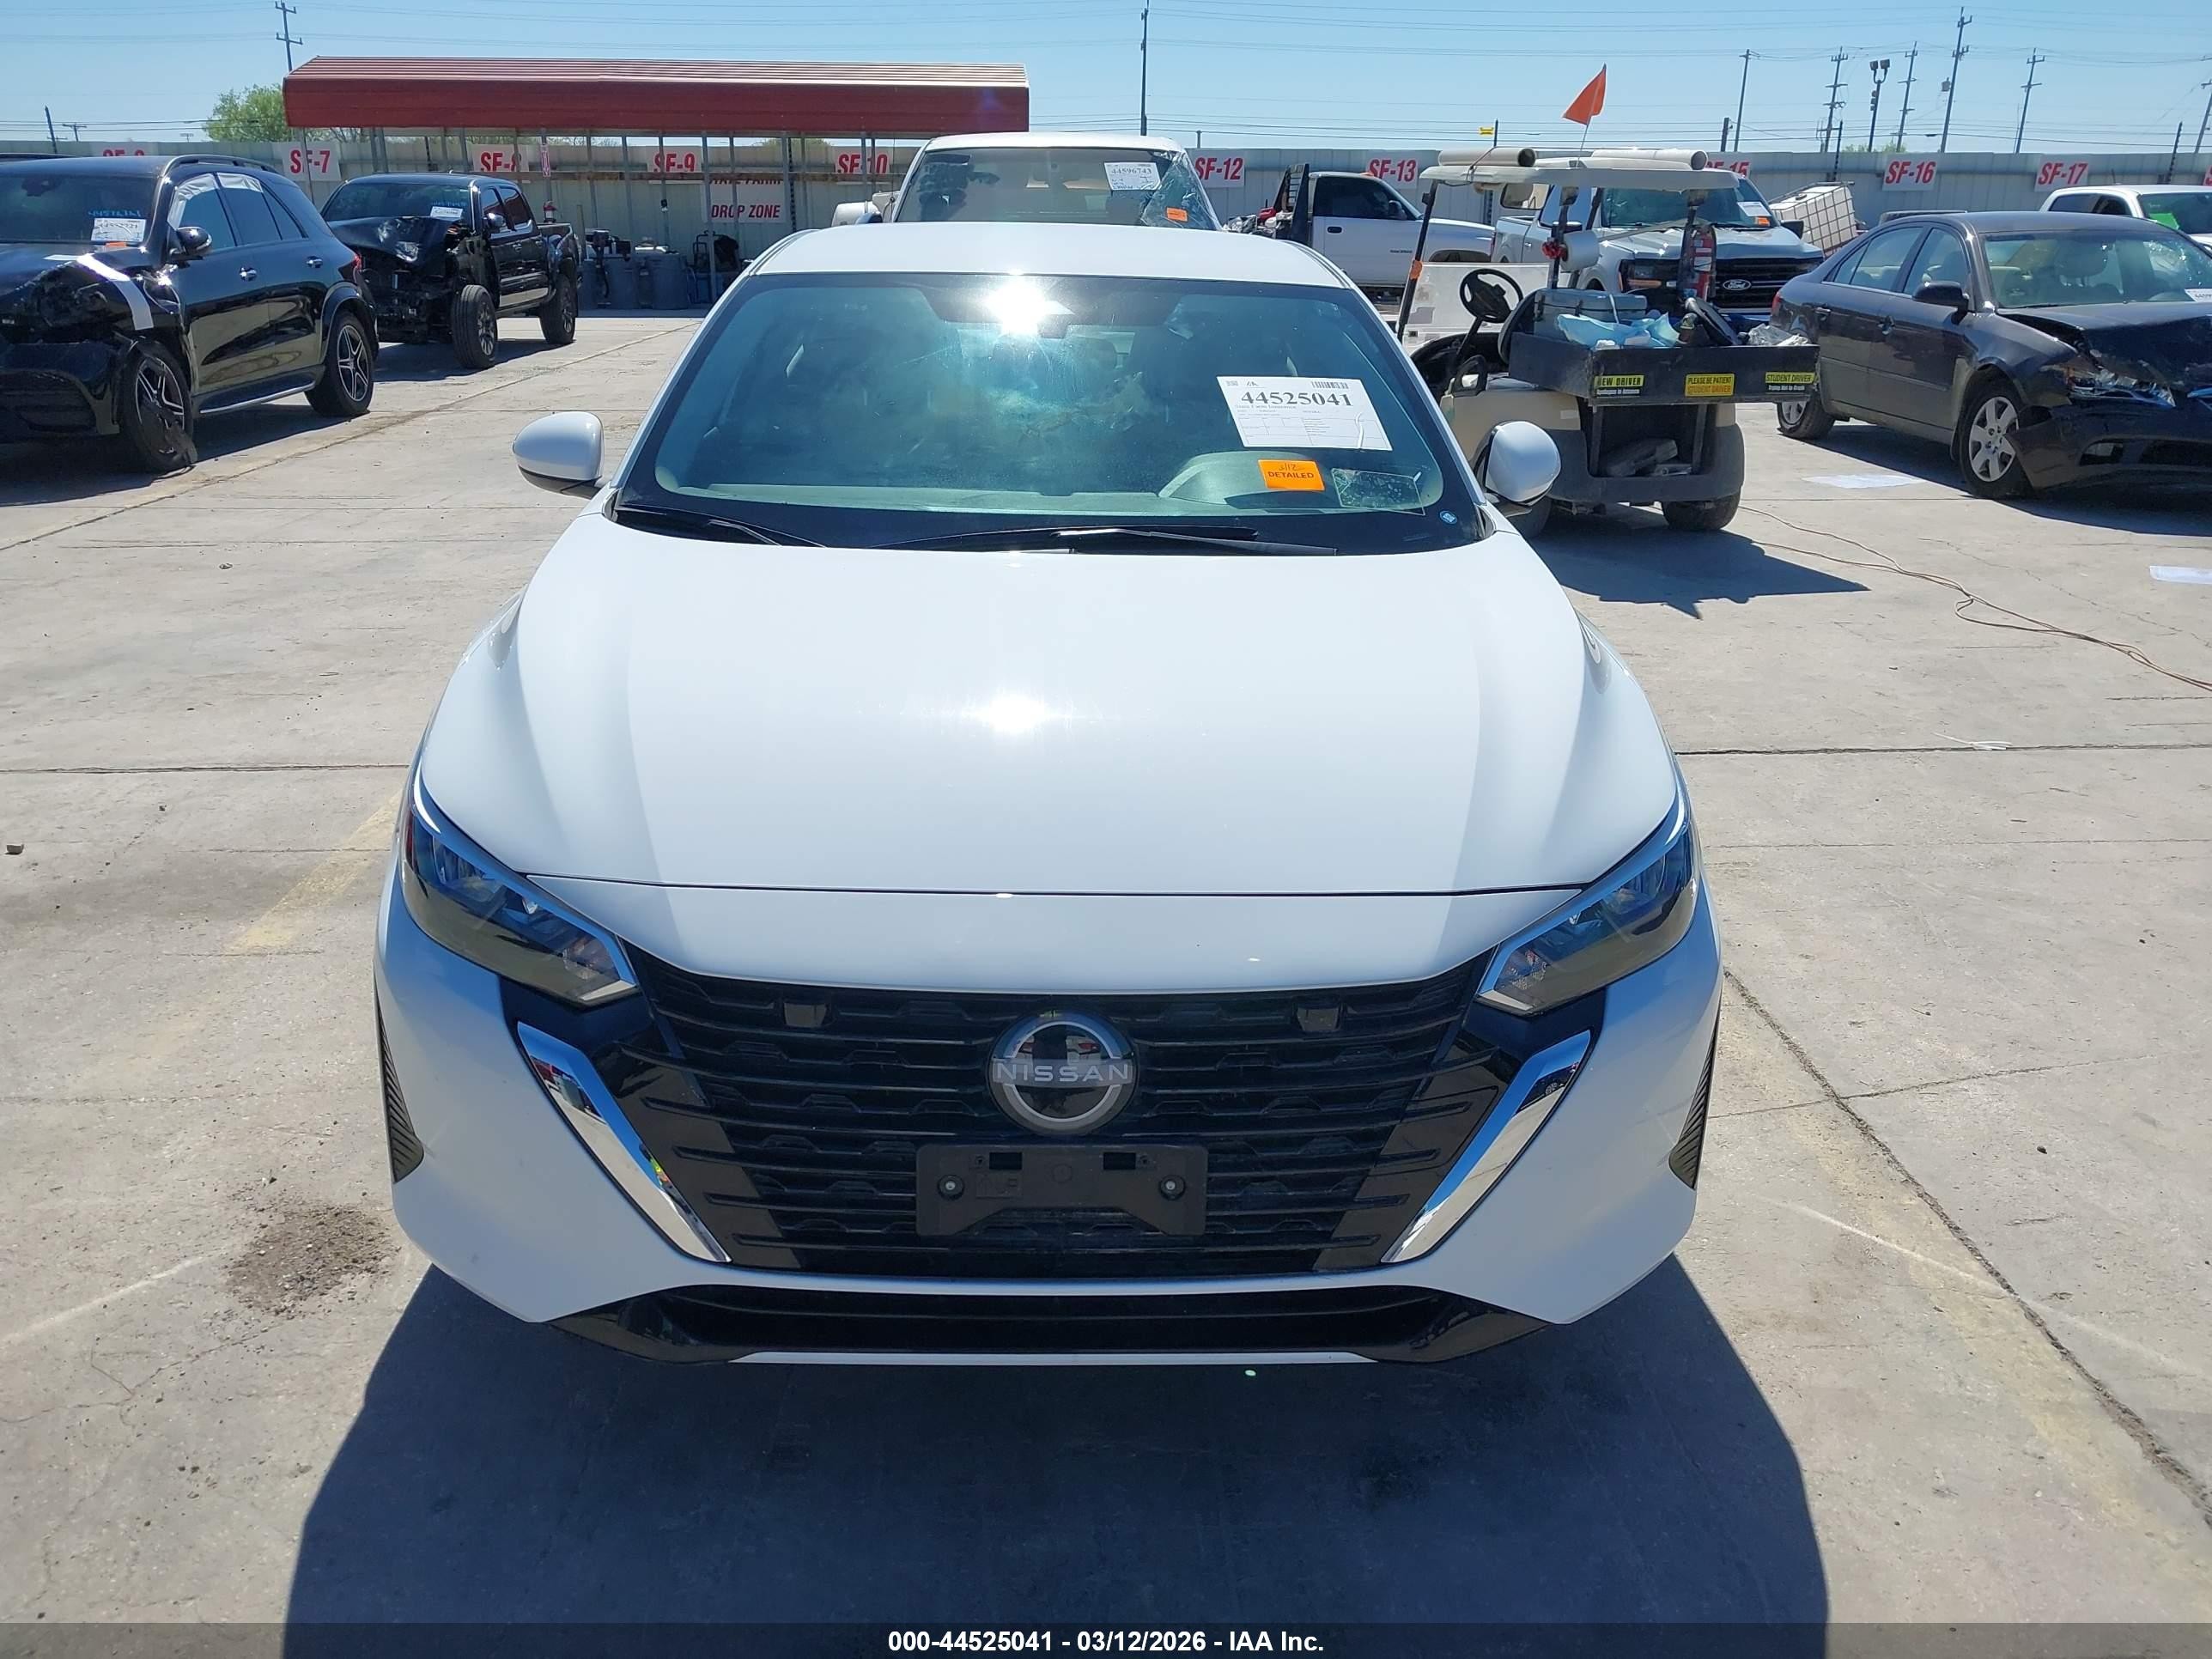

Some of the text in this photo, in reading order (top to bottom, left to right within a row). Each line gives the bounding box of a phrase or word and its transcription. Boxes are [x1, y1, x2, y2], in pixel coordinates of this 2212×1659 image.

[289, 149, 331, 173] SF-7
[838, 154, 888, 173] SF10
[1194, 157, 1243, 180] SF-12
[1370, 159, 1417, 182] SF-13
[1885, 161, 1936, 184] SF-16
[2038, 162, 2088, 185] SF-17
[749, 204, 781, 218] ZONE
[1615, 377, 1641, 386] DRIVER
[1766, 374, 1790, 382] STUDENT
[1241, 391, 1354, 407] 44525041
[996, 1063, 1128, 1083] NISSAN
